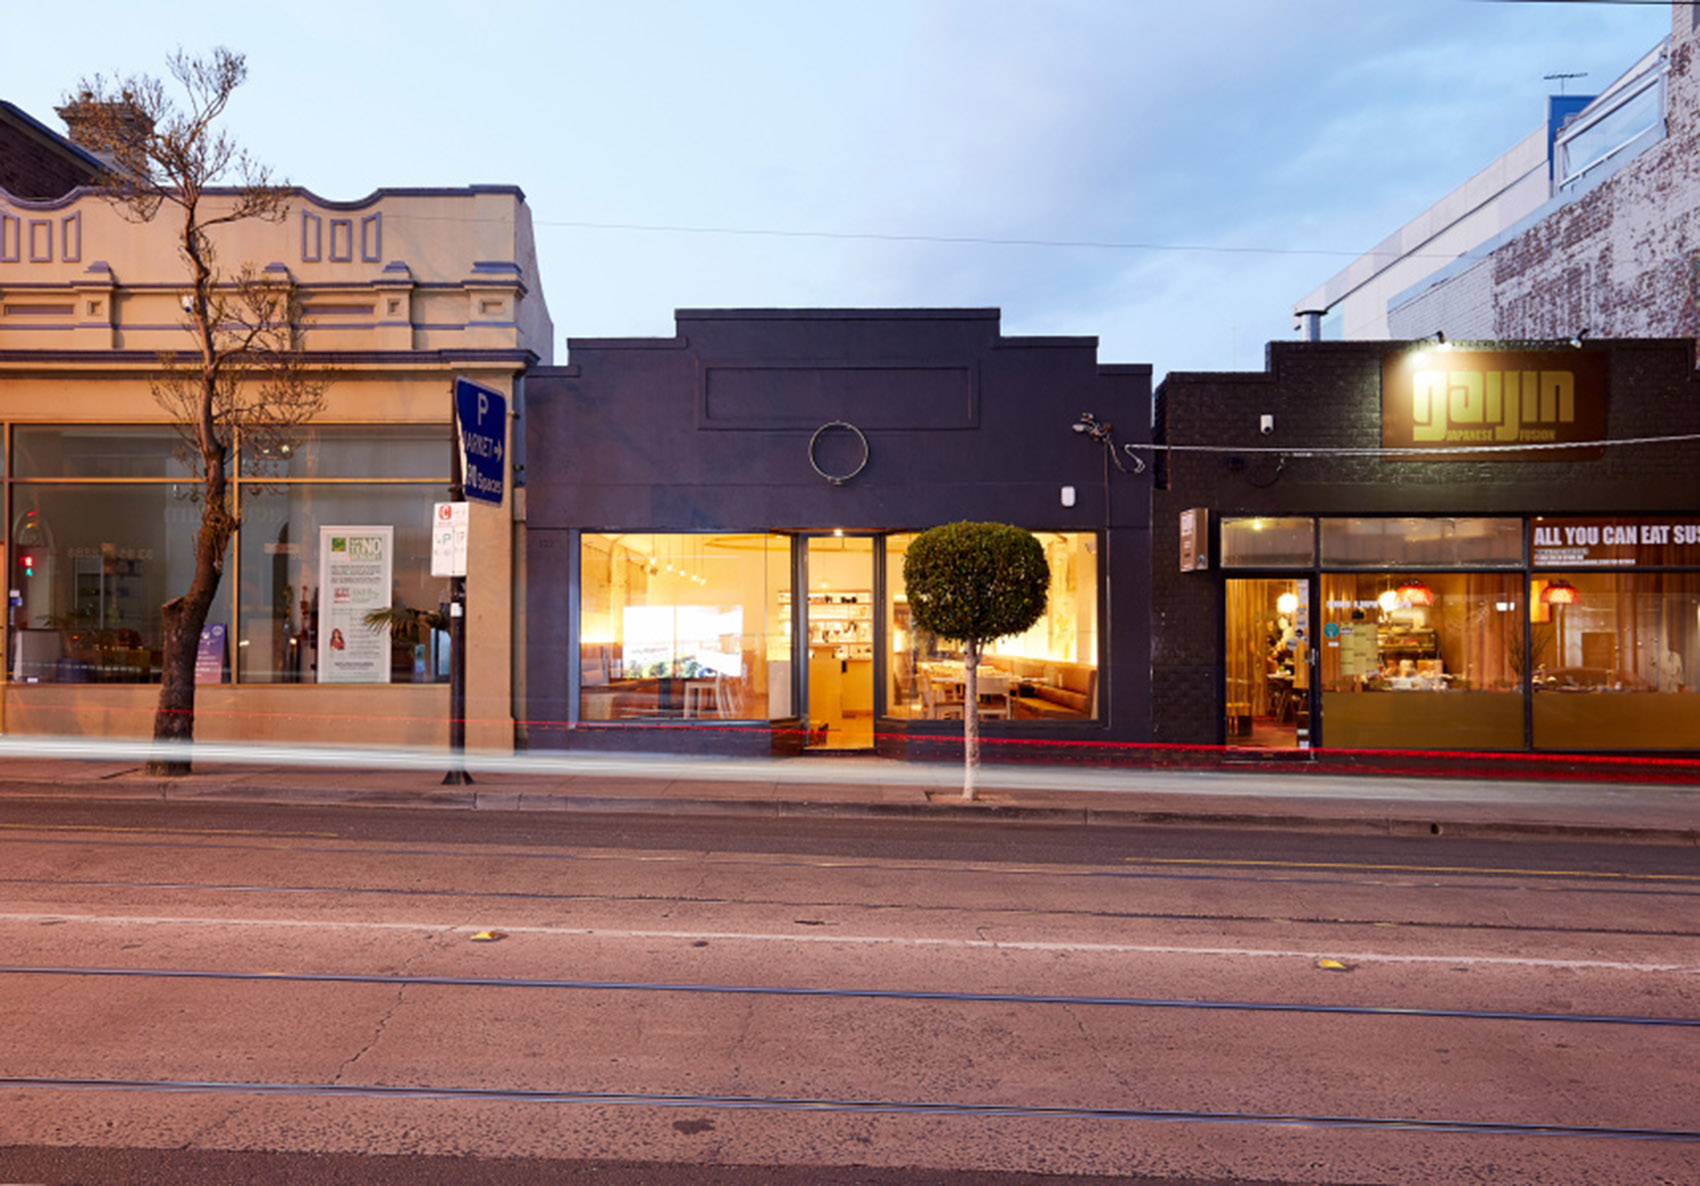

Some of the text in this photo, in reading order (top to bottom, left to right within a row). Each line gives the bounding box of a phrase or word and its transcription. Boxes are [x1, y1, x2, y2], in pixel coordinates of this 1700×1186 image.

[477, 391, 489, 426] P
[1446, 429, 1557, 441] JAPANESE FUSION
[478, 472, 503, 495] Spaces
[1534, 526, 1562, 545] ALL
[1565, 526, 1599, 545] YOU
[1602, 525, 1638, 545] CAN
[1641, 525, 1670, 544] EAT
